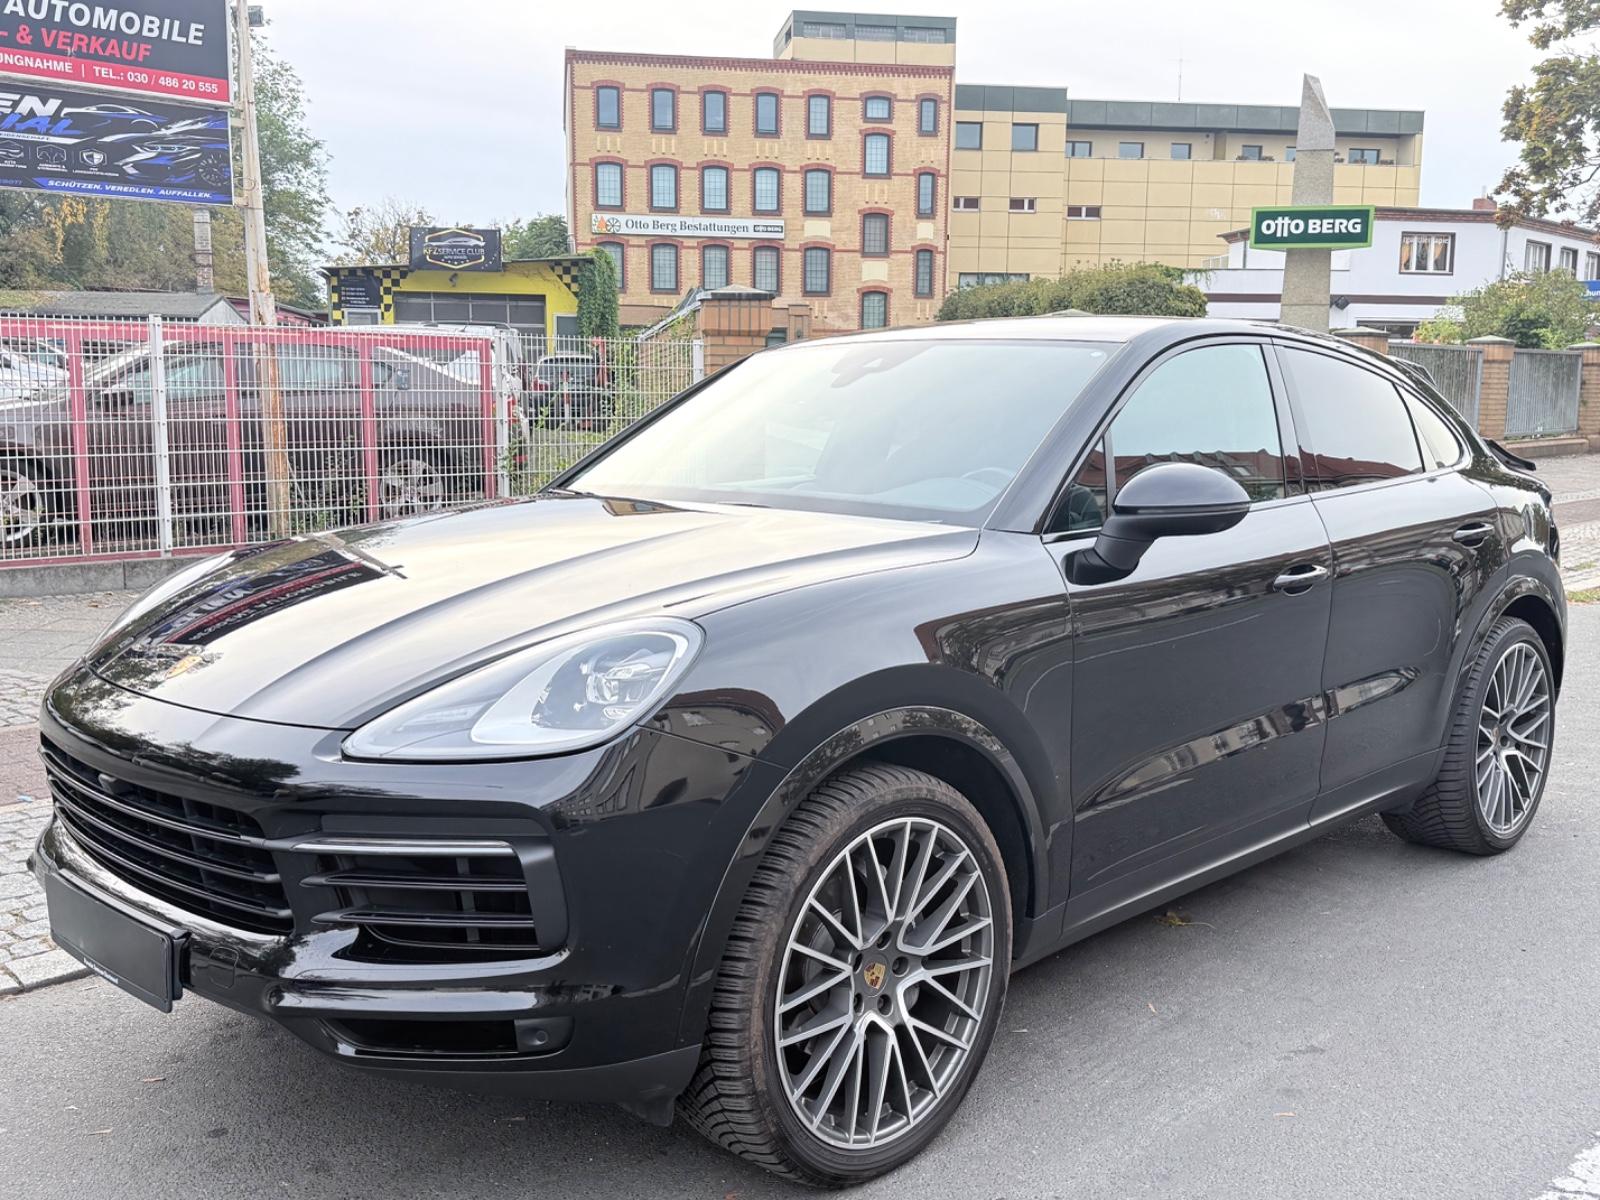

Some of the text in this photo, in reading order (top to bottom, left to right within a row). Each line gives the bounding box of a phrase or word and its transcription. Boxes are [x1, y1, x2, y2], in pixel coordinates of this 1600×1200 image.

[4, 0, 205, 46] AUTOMOBILE
[16, 24, 152, 62] & VERKAUF
[93, 66, 124, 81] TEL.:
[127, 71, 149, 84] 030
[158, 76, 180, 89] 486
[182, 79, 196, 90] 20
[198, 81, 219, 94] 555
[0, 112, 85, 135] IAL
[48, 179, 212, 199] SCHÜTZEN. VEREDLEN. AUFFALLEN.
[625, 218, 749, 235] Otto Berg Bestattungen
[1307, 218, 1362, 234] BERG
